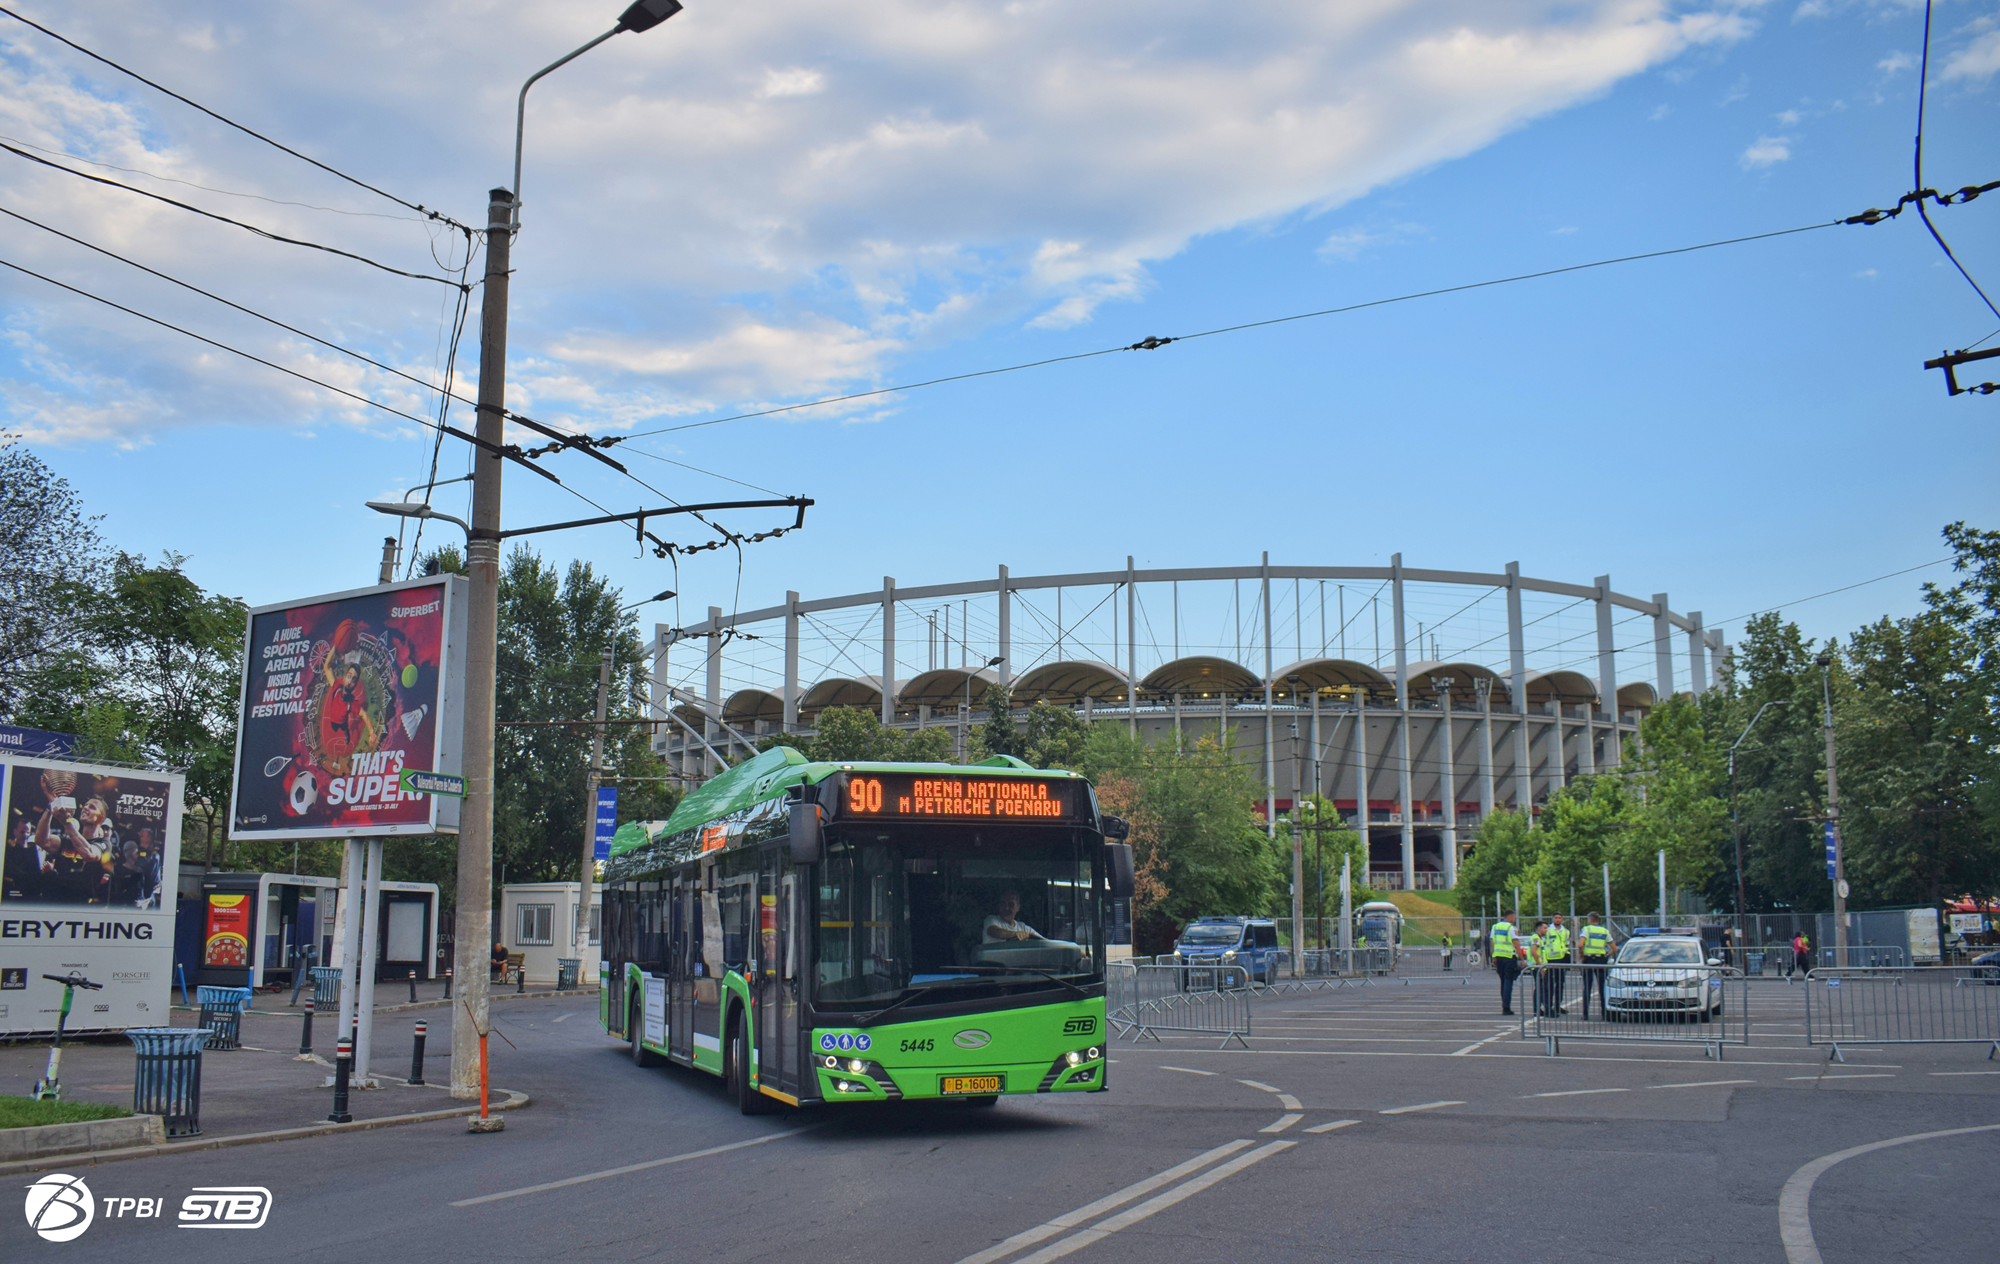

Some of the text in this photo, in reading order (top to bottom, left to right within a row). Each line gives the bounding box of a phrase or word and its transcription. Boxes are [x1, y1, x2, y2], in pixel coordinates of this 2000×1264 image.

[391, 600, 440, 618] SUPERBET
[273, 626, 302, 642] A HUGE
[263, 640, 310, 659] SPORTS
[264, 656, 305, 673] ARENA
[267, 671, 300, 688] INSIDE A
[263, 685, 303, 702] MUSIC
[251, 699, 313, 718] FESTIVAL?
[351, 750, 405, 776] THAT'S
[850, 779, 882, 812] 90
[914, 780, 1047, 800] ARENA NATIONALA
[116, 805, 163, 820] It all adds up
[899, 796, 1061, 816] M PETRACHE POENARU
[0, 920, 153, 940] ERYTHING
[1469, 954, 1479, 963] 30
[1063, 1019, 1094, 1033] STB
[900, 1038, 934, 1053] 5445
[955, 1077, 996, 1090] B 16010
